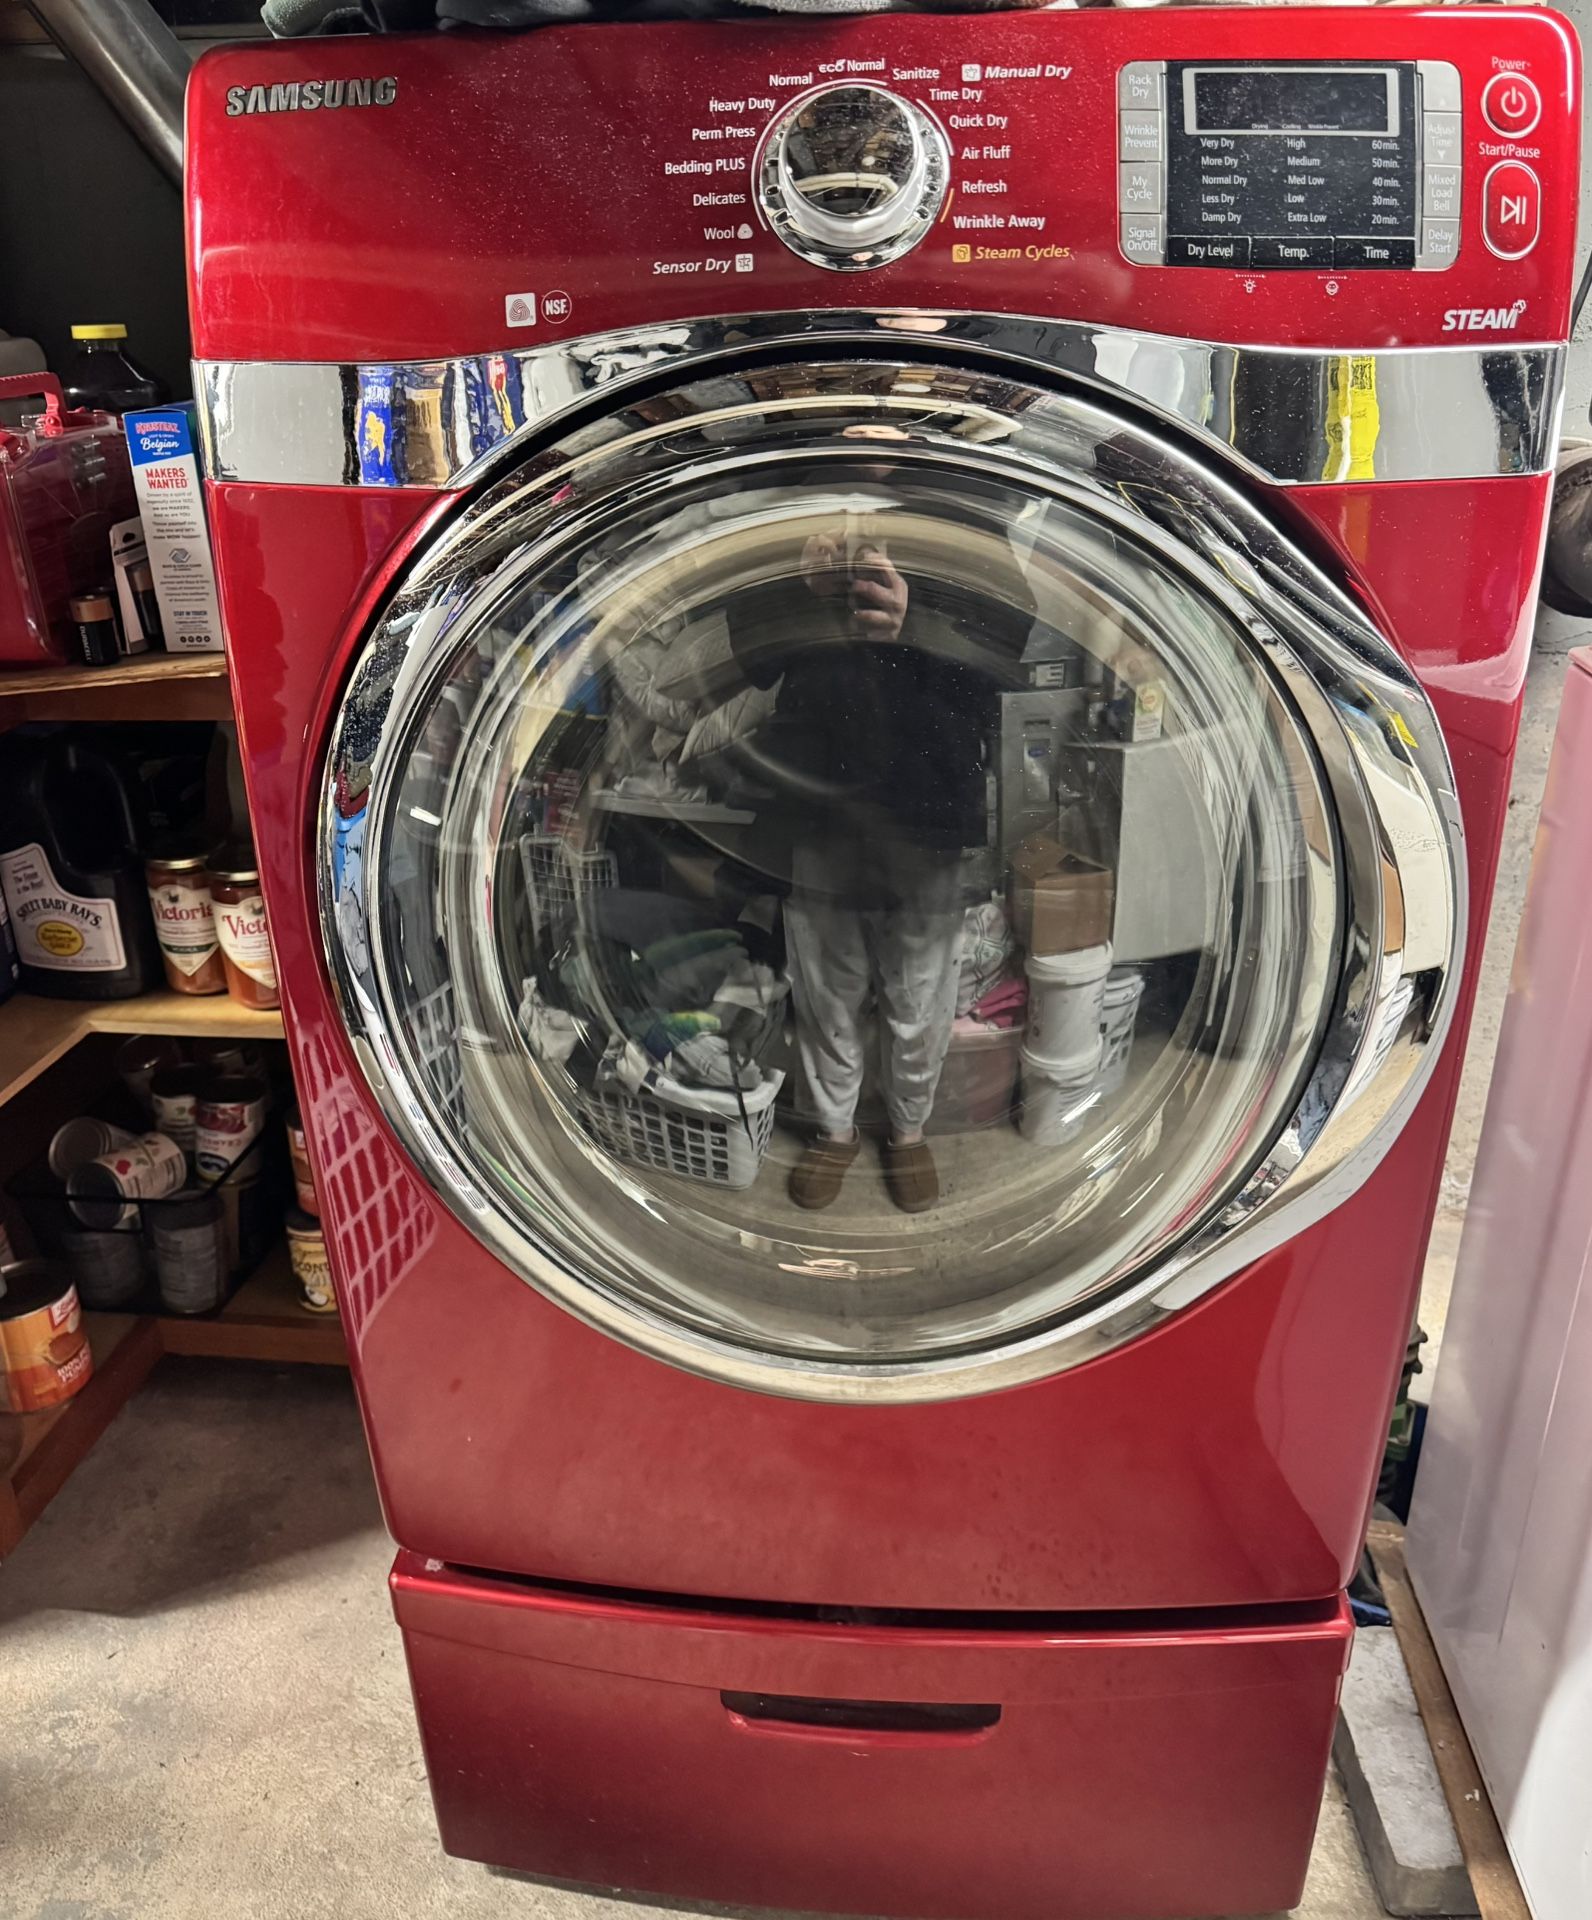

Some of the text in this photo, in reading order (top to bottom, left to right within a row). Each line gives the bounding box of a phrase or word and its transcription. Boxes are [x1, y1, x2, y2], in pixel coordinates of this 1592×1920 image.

[847, 58, 885, 72] Normal
[1491, 56, 1526, 69] Power
[893, 67, 940, 81] Sanitize
[985, 65, 1072, 80] Manual Dry
[769, 72, 813, 87] Normal
[1128, 75, 1152, 86] Rack
[226, 75, 398, 117] SAMSUNG
[929, 87, 983, 103] Time Dry
[1132, 86, 1149, 99] Dry
[709, 97, 776, 114] Heavy Duty
[949, 114, 1008, 129] Quick Dry
[692, 126, 756, 141] Perm Press
[1124, 124, 1158, 136] Wrinkle
[1124, 137, 1158, 148] Prevent
[1200, 138, 1235, 150] Very Dry
[1287, 138, 1306, 150] High
[1431, 136, 1454, 148] Time
[961, 145, 1011, 159] Air Fluff
[1478, 142, 1541, 159] Start/Pause
[664, 157, 745, 175] Bedding PLUS
[1201, 156, 1239, 168] More Dry
[1287, 156, 1320, 167] Medium
[962, 179, 1007, 193] Refresh
[1132, 176, 1148, 189] My
[1201, 175, 1247, 187] Normal Dry
[1287, 176, 1325, 186] Med Low
[1428, 174, 1456, 186] Mixed
[693, 192, 746, 207] Delicates
[1126, 188, 1152, 201] Cycle
[1287, 194, 1305, 204] Low
[1431, 187, 1453, 199] Load
[1202, 194, 1235, 206] Less Dry
[1433, 199, 1450, 211] Bell
[953, 214, 1046, 230] Wrinkle Away
[1201, 213, 1242, 225] Damp Dry
[1287, 213, 1327, 223] Extra Low
[703, 225, 735, 240] Wool
[1128, 227, 1156, 239] Signal
[1428, 228, 1454, 243] Delay
[975, 244, 1070, 259] Steam Cycles
[1127, 240, 1158, 252] On/Off
[1187, 244, 1234, 257] Dry Level
[1278, 245, 1310, 260] Temp.
[1429, 242, 1451, 254] Start
[1364, 246, 1390, 260] Time
[652, 258, 732, 274] Sensor Dry
[1441, 309, 1519, 331] STEAM
[140, 437, 180, 452] Belgian
[145, 467, 186, 479] MAKERS
[147, 478, 188, 489] WANTED
[40, 898, 69, 911] BABY
